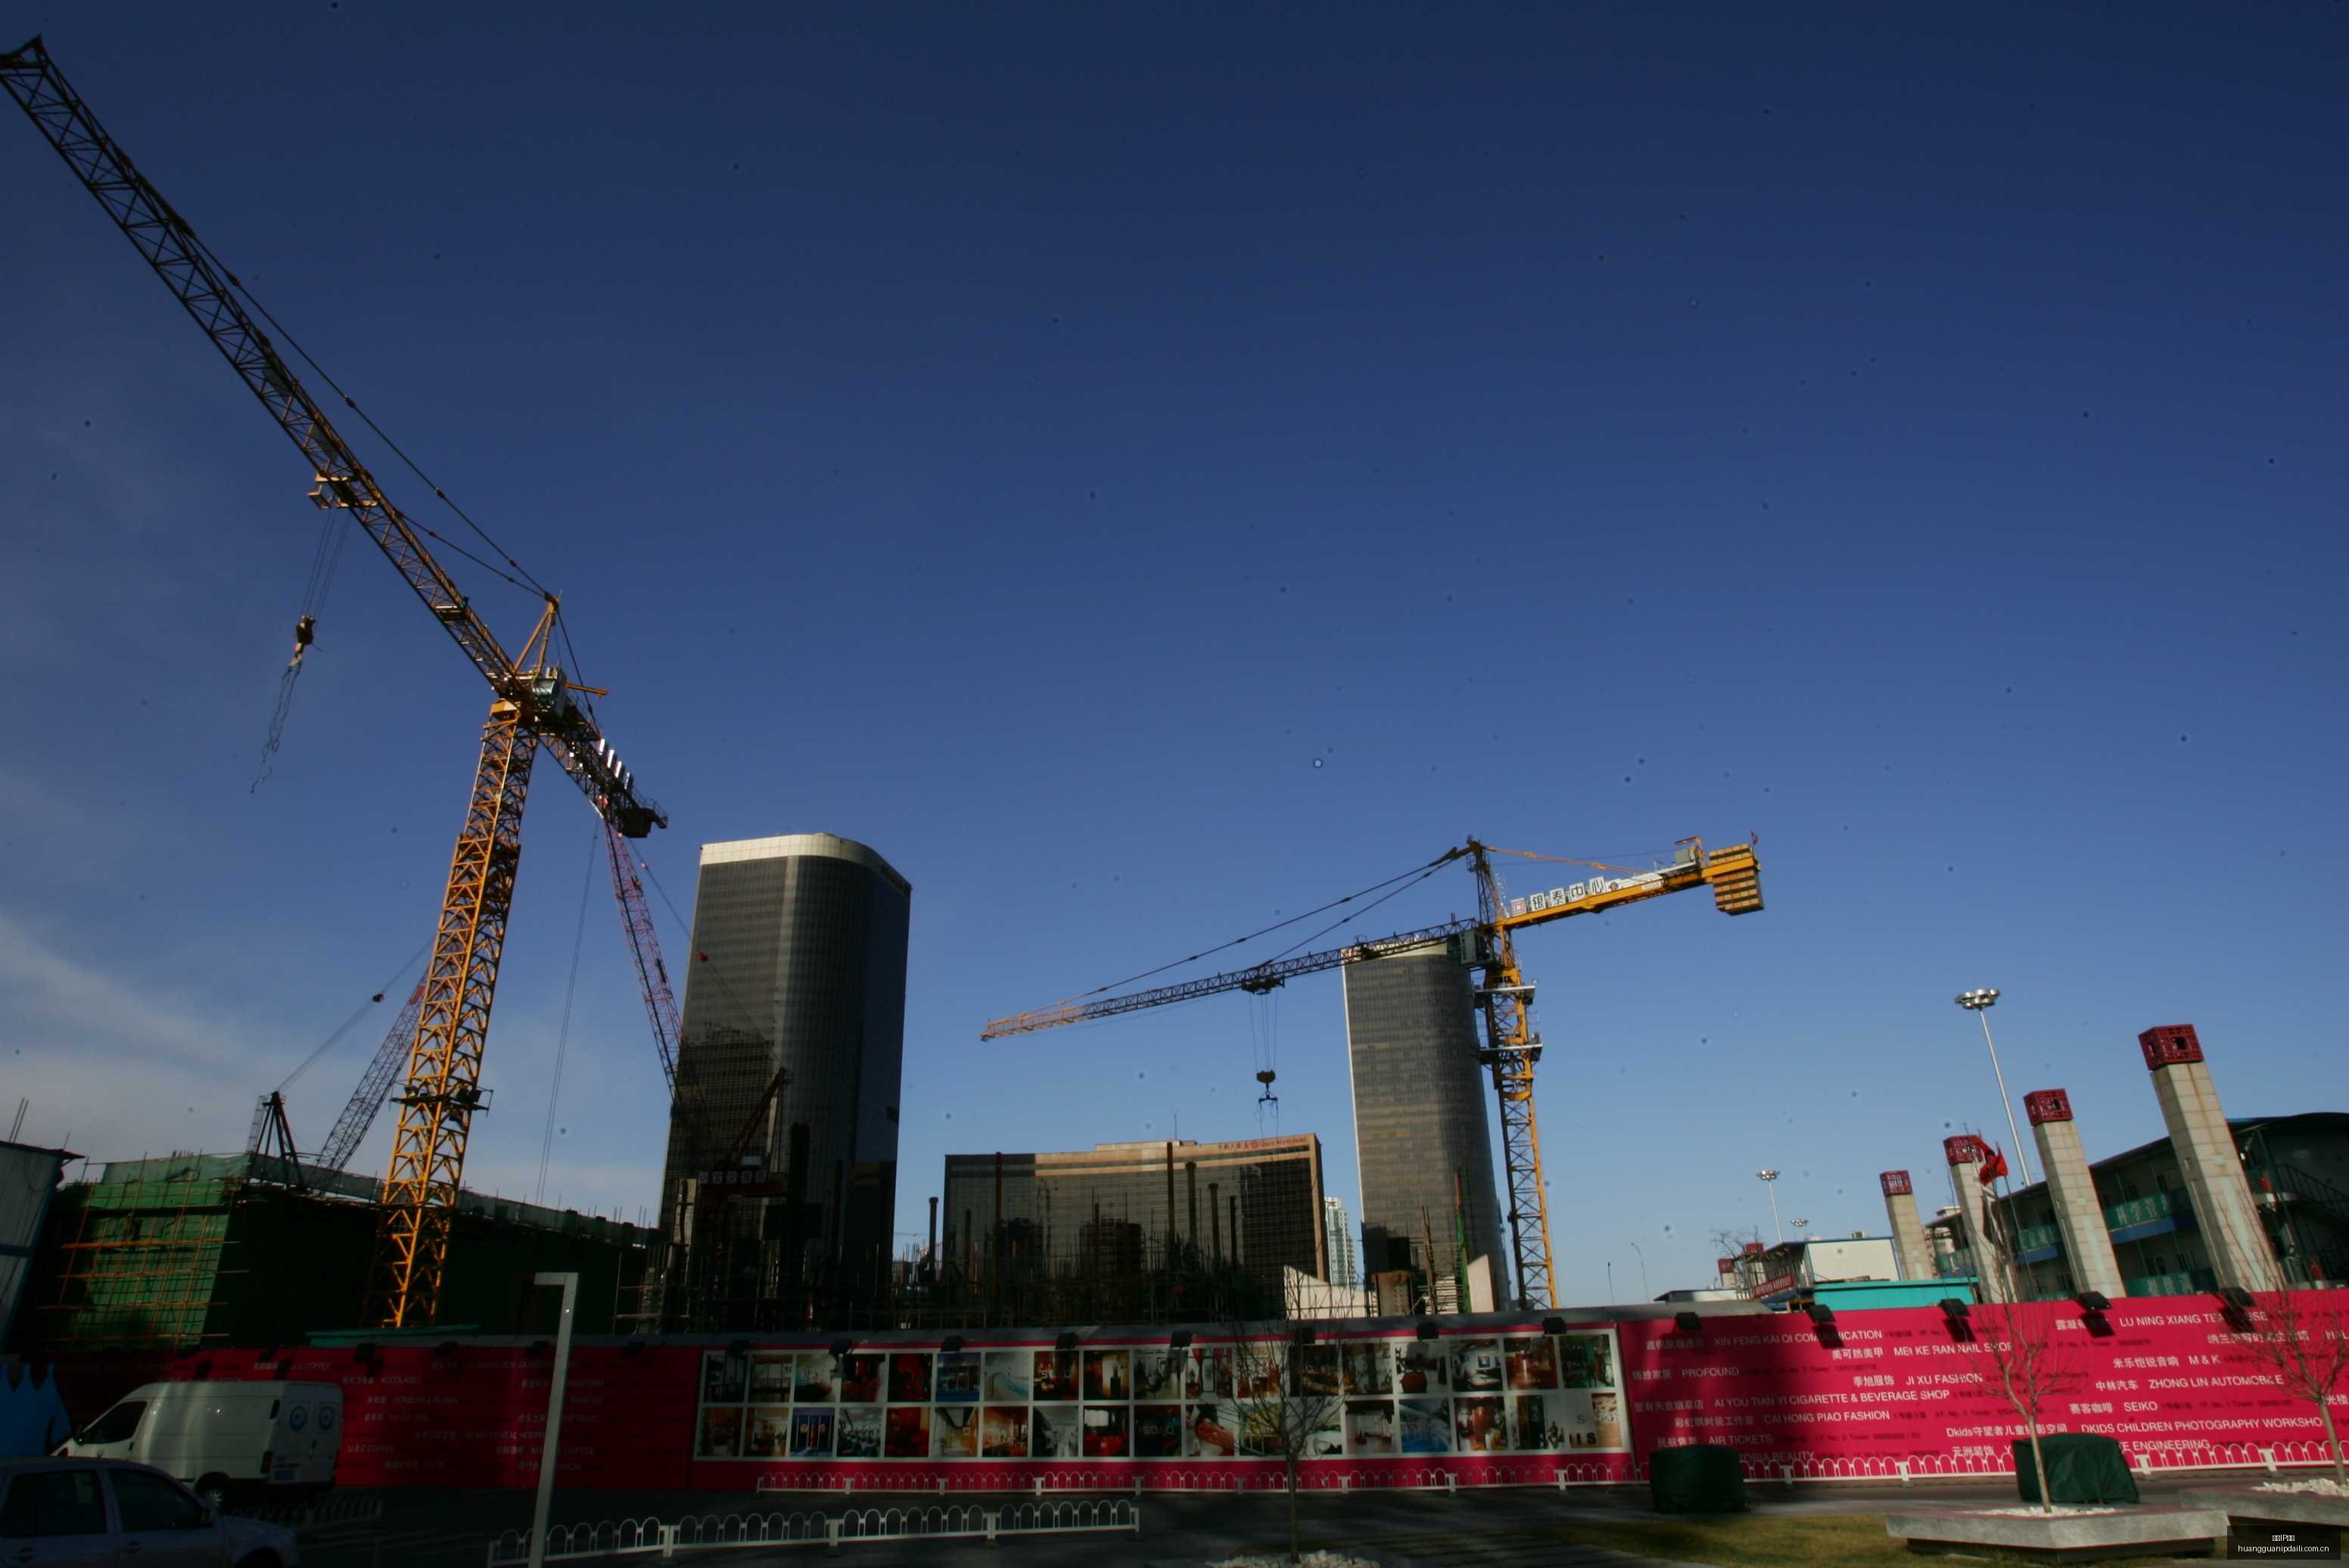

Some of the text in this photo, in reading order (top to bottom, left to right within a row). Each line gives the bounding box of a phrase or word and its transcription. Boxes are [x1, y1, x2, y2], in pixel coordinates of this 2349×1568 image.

[1530, 876, 1604, 910] 银泰中心
[2119, 1317, 2135, 1327] LU
[2136, 1316, 2165, 1326] NING
[2167, 1315, 2201, 1325] XIANG
[1714, 1337, 1731, 1346] XIN
[1734, 1336, 1761, 1346] FENG
[1763, 1335, 1779, 1344] KAI
[1782, 1334, 1792, 1343] QI
[1832, 1347, 1883, 1360] 美可然美甲
[1893, 1347, 1912, 1357] MEI
[1915, 1346, 1930, 1355] KE
[1934, 1345, 1955, 1355] RAN
[1957, 1344, 1980, 1353] NAIL
[2189, 1356, 2198, 1365] M
[2201, 1355, 2209, 1364] &
[2211, 1355, 2220, 1364] K
[1682, 1367, 1739, 1378] PROFOUND
[1906, 1376, 1915, 1385] JI
[1918, 1375, 1932, 1384] XU
[1935, 1373, 1983, 1383] FASHION
[2095, 1375, 2284, 1392] 中林汽车 ZHONG LIN AUTOMOBILE
[1714, 1398, 1724, 1408] AI
[1725, 1398, 1749, 1408] YOU
[1750, 1397, 1775, 1406] TIAN
[1778, 1396, 1787, 1405] YI
[1790, 1394, 1848, 1405] CIGARETTE
[1851, 1393, 1858, 1402] &
[1861, 1391, 1918, 1402] BEVERAGE
[1920, 1389, 1950, 1400] SHOP
[2123, 1402, 2158, 1412] SEIKO
[1764, 1415, 1782, 1424] CAI
[1785, 1414, 1814, 1423] HONG
[1817, 1413, 1841, 1422] PIAO
[1843, 1410, 1890, 1421] FASHION
[2117, 1422, 2173, 1433] CHILDREN
[2175, 1420, 2260, 1431] PHOTOGRAPHY
[2263, 1417, 2323, 1428] WORKSHO
[1708, 1435, 1726, 1445] AIR
[1729, 1434, 1772, 1445] TICKETS
[2133, 1439, 2211, 1451] ENGINEERING
